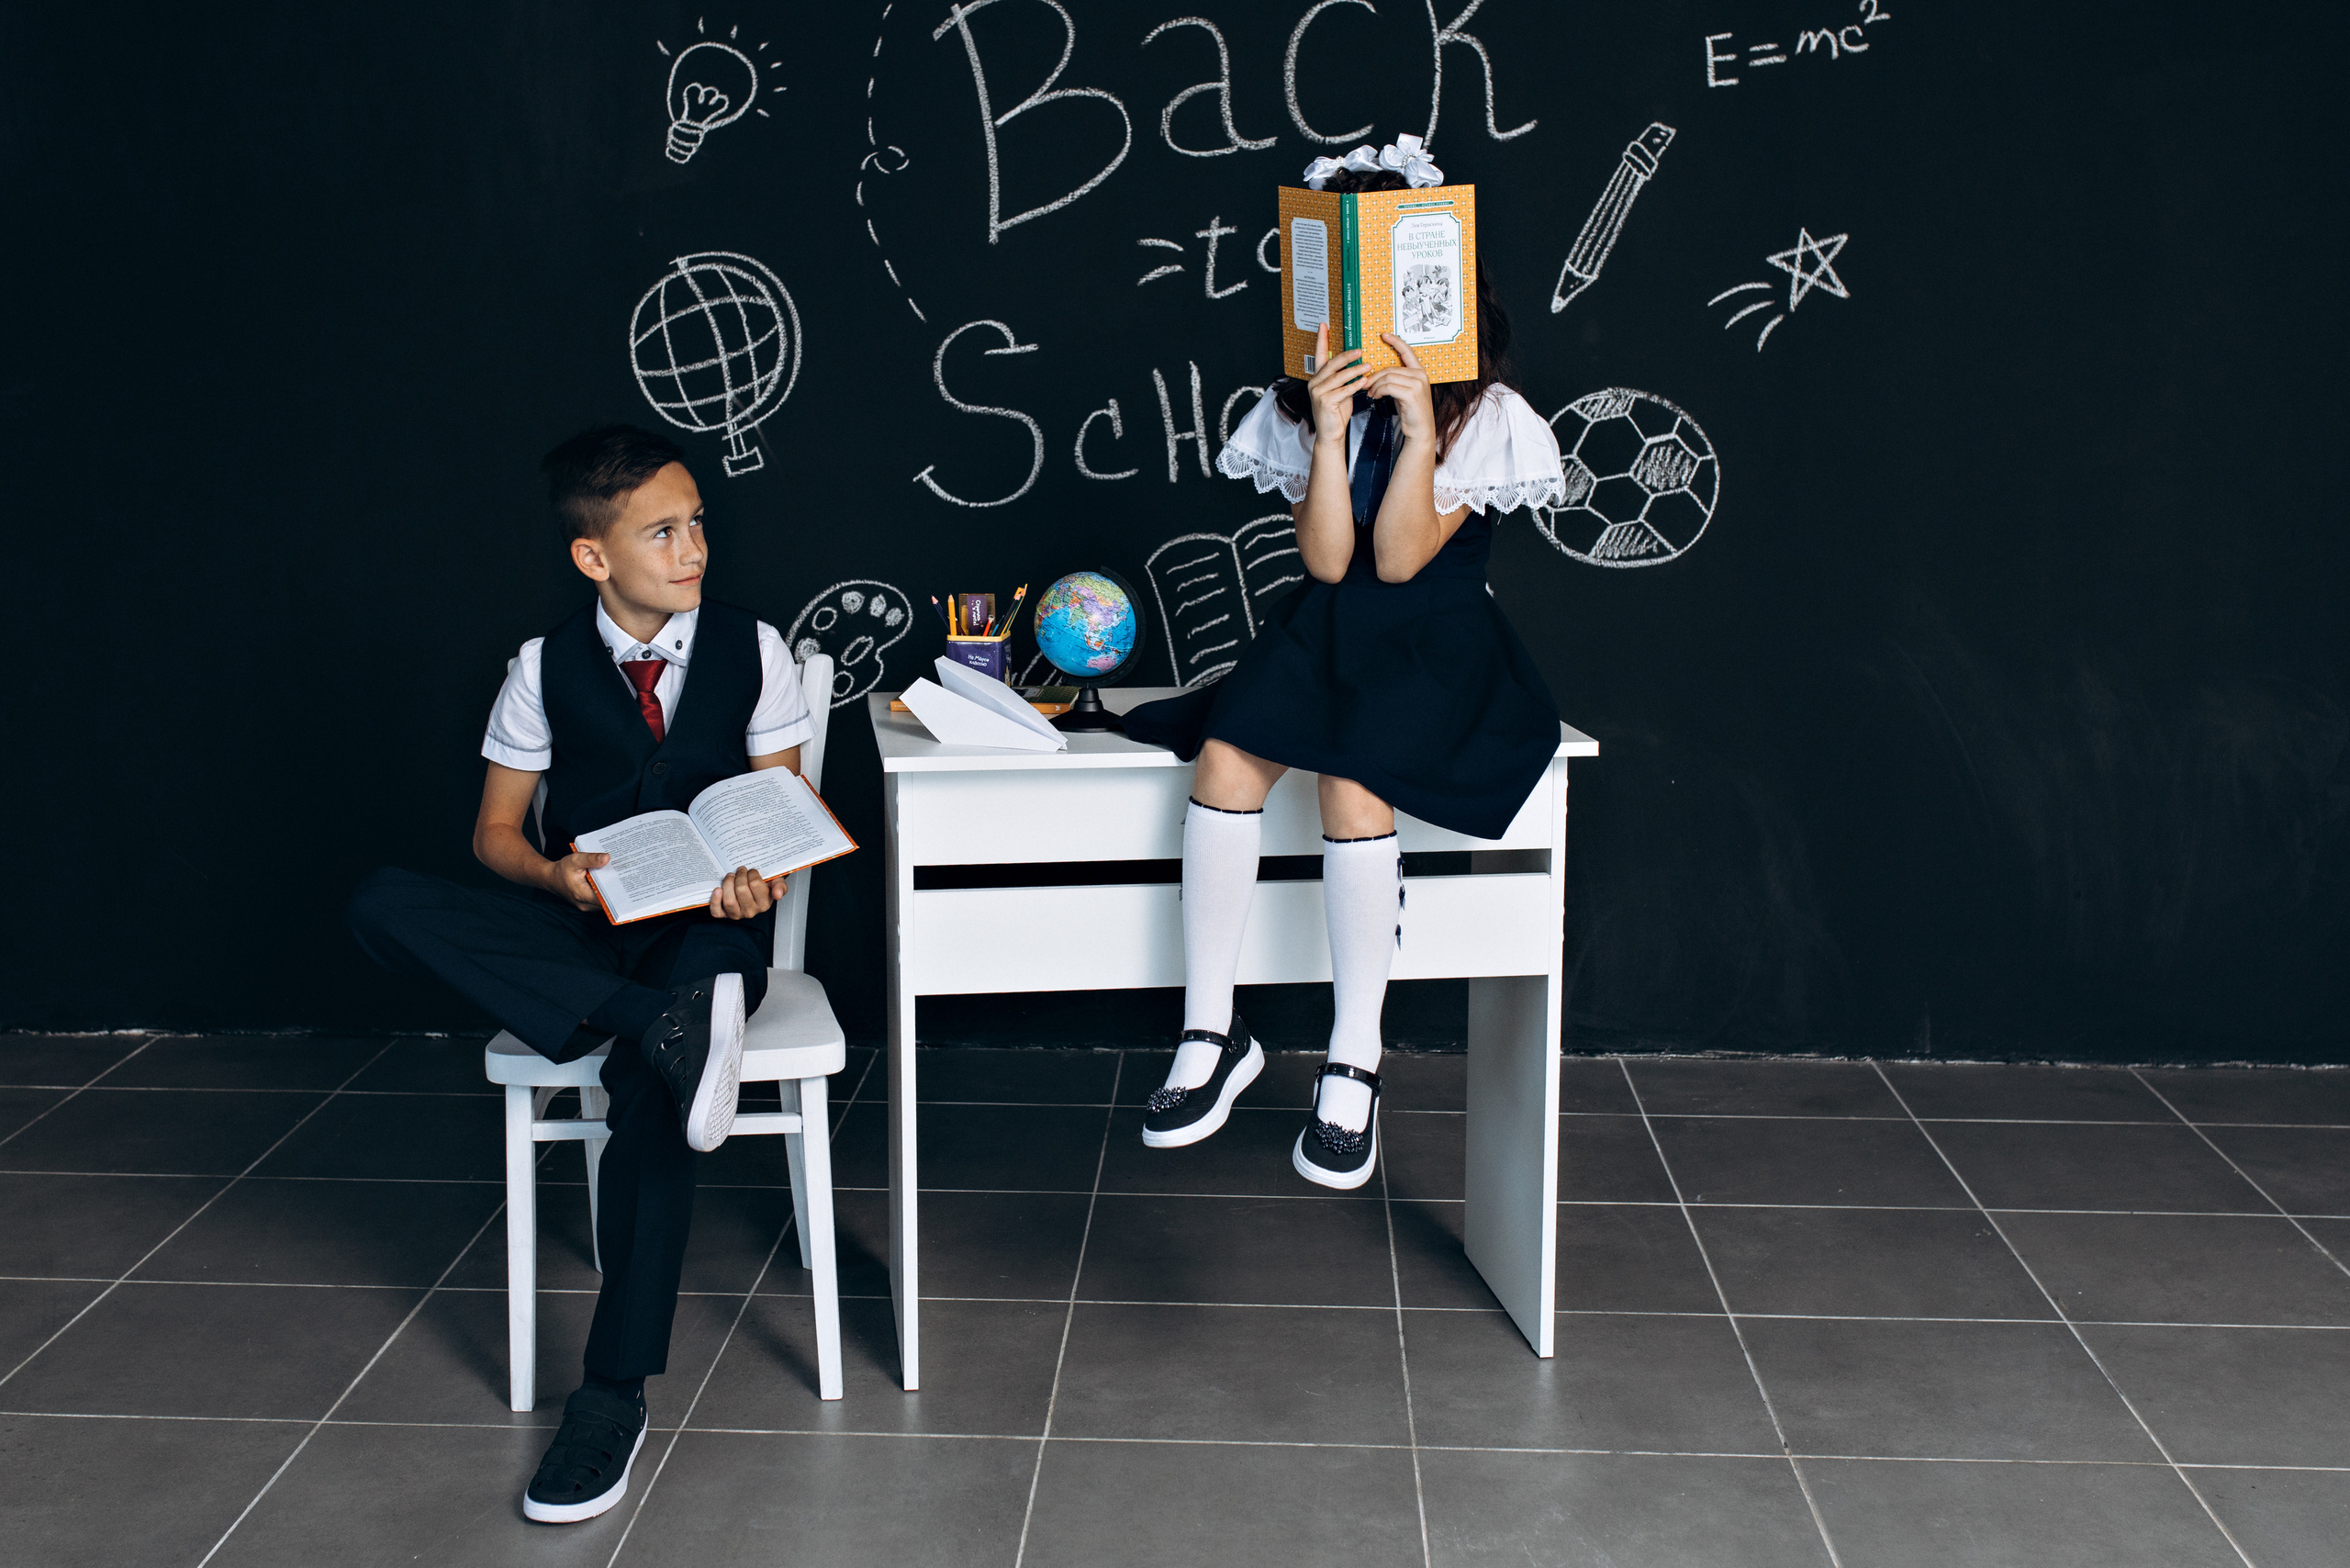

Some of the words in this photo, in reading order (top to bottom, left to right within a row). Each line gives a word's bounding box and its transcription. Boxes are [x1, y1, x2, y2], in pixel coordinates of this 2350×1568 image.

[1416, 230, 1445, 240] СТРАНЕ
[1397, 239, 1457, 251] НЕВЫУЧЕННЫХ
[1411, 249, 1443, 259] УРОКОВ
